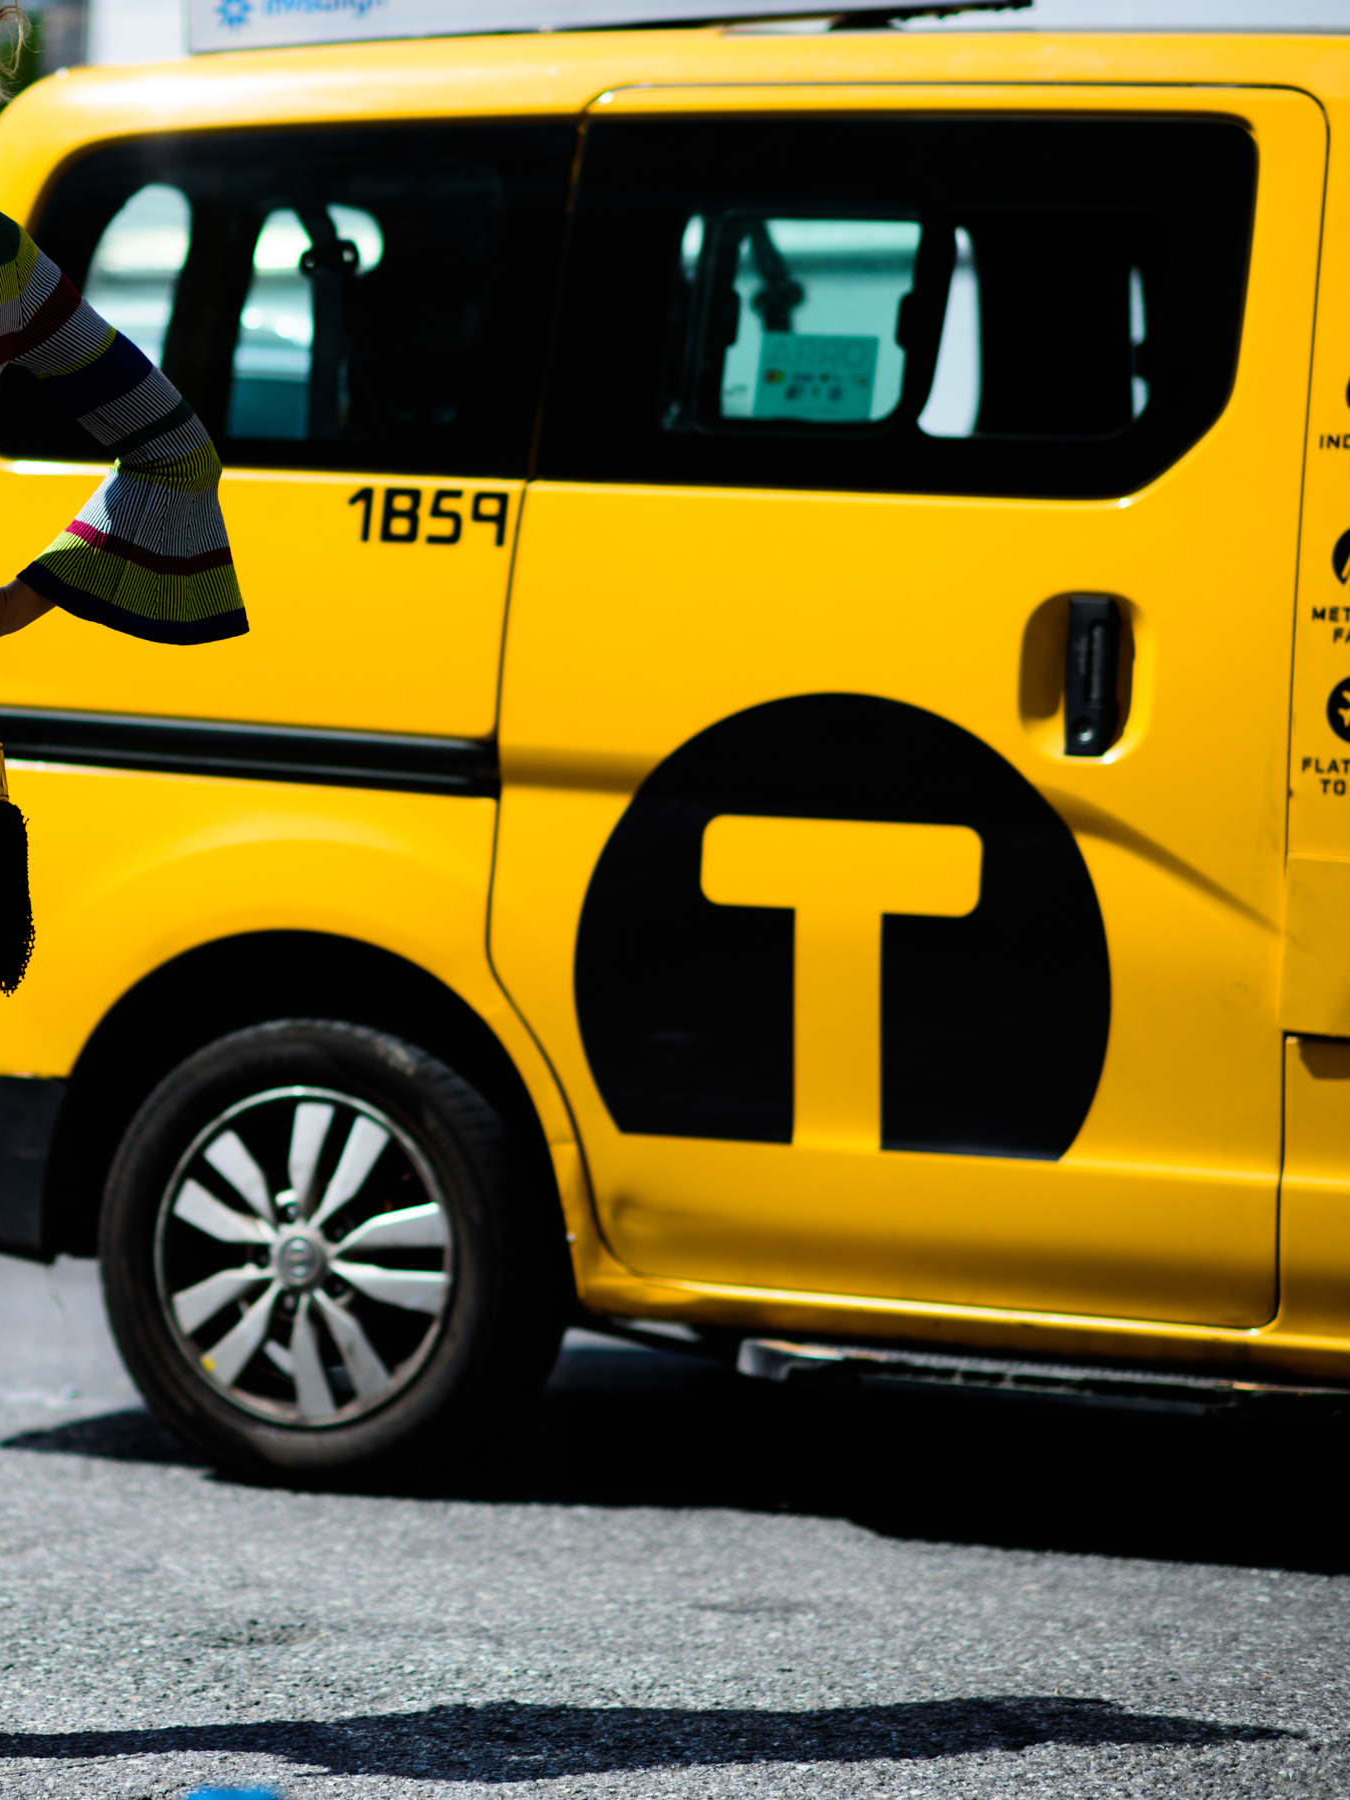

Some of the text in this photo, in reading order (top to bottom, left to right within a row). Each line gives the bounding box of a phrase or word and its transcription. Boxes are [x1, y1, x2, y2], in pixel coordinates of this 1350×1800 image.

[348, 487, 509, 547] 1B59
[1311, 606, 1350, 622] MET
[1301, 757, 1350, 774] FLAT
[1319, 778, 1347, 796] TO
[700, 814, 983, 1150] T
